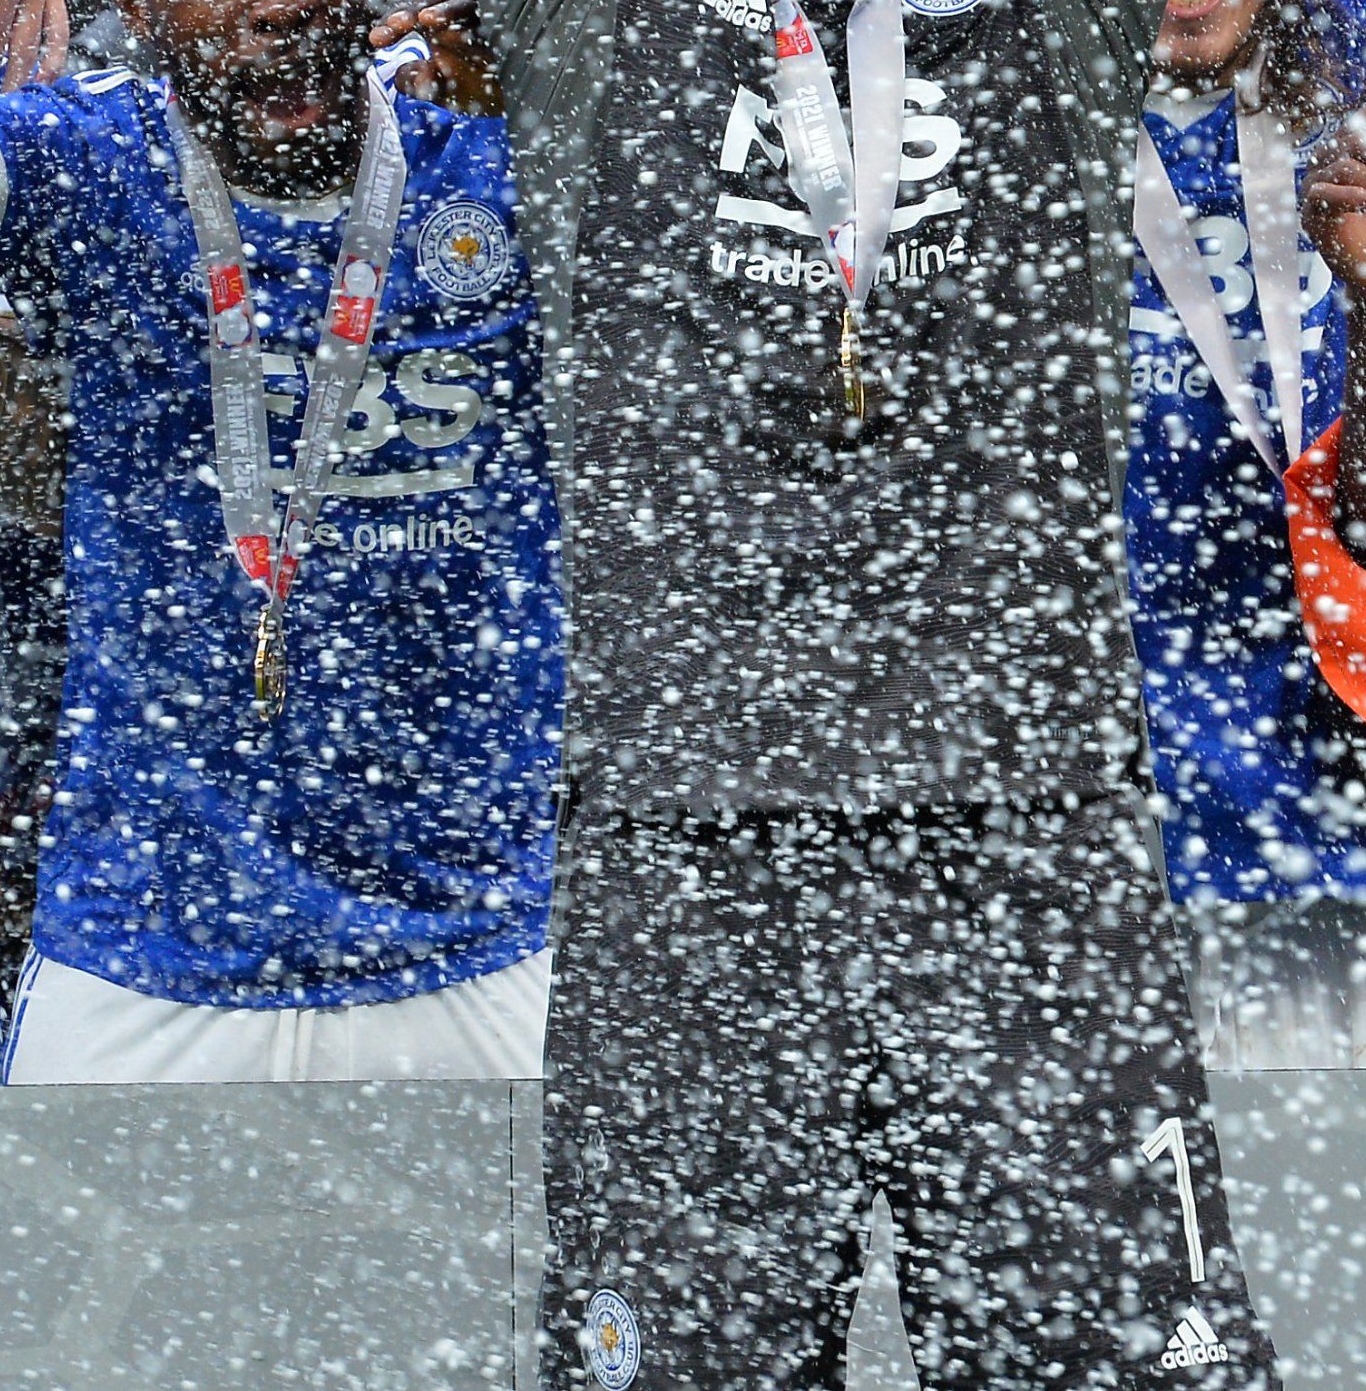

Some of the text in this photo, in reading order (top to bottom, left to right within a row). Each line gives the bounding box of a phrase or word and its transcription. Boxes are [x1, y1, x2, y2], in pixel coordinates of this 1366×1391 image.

[794, 82, 826, 124] 2021
[804, 123, 846, 192] WINNER
[362, 163, 398, 230] WINNER
[474, 212, 497, 236] CITY
[710, 234, 967, 289] trade nline
[1130, 354, 1210, 399] ade
[223, 381, 251, 451] WINNER
[230, 454, 255, 501] 2021
[351, 511, 473, 555] online
[1140, 1117, 1205, 1283] 1
[1161, 1342, 1229, 1370] adidas
